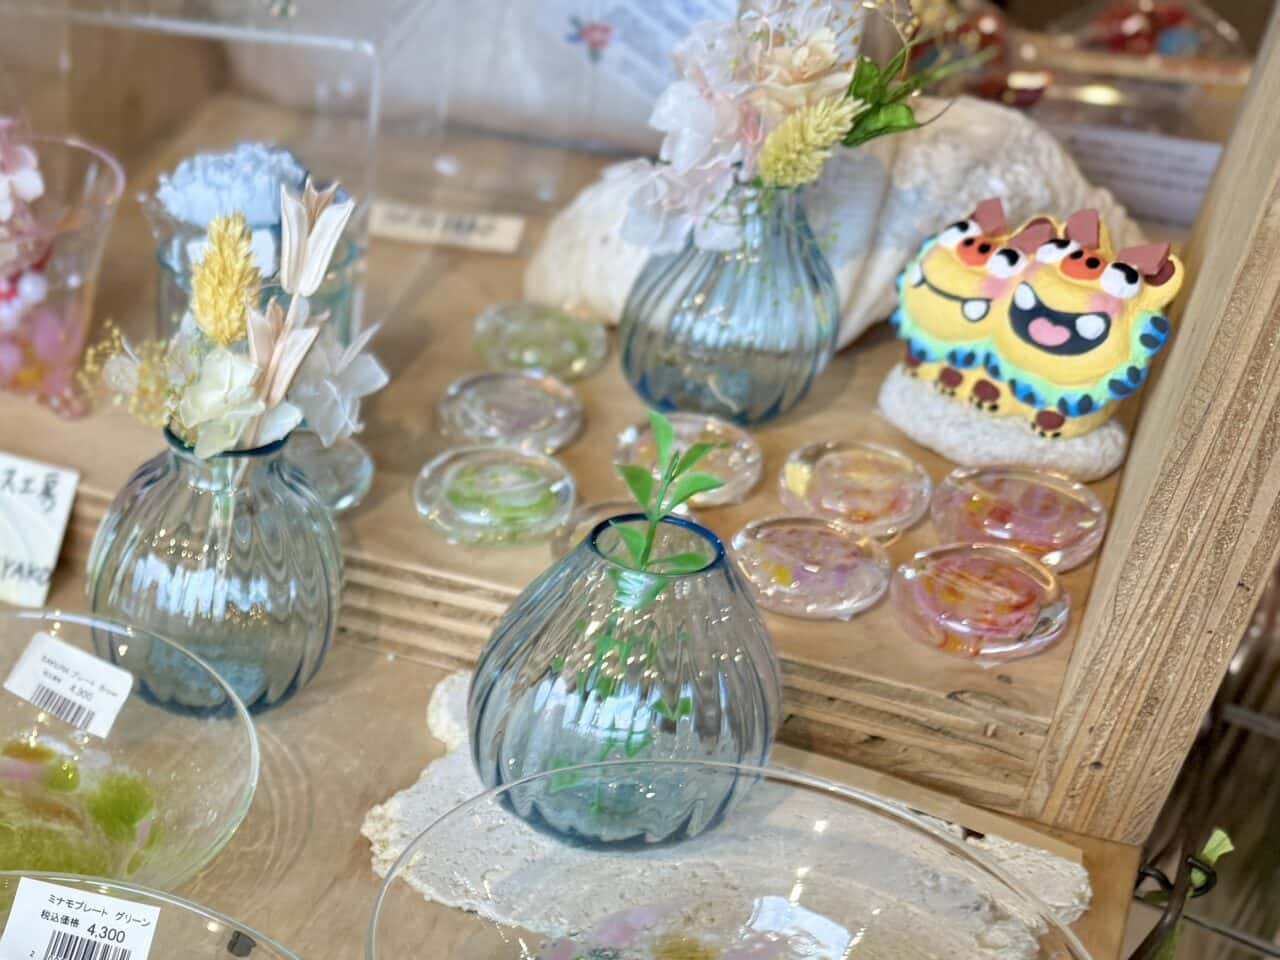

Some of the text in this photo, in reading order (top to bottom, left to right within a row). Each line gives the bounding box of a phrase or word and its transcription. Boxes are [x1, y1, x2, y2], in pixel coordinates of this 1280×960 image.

[40, 909, 126, 944] 税込価格 4,300
[114, 911, 152, 928] グリーン
